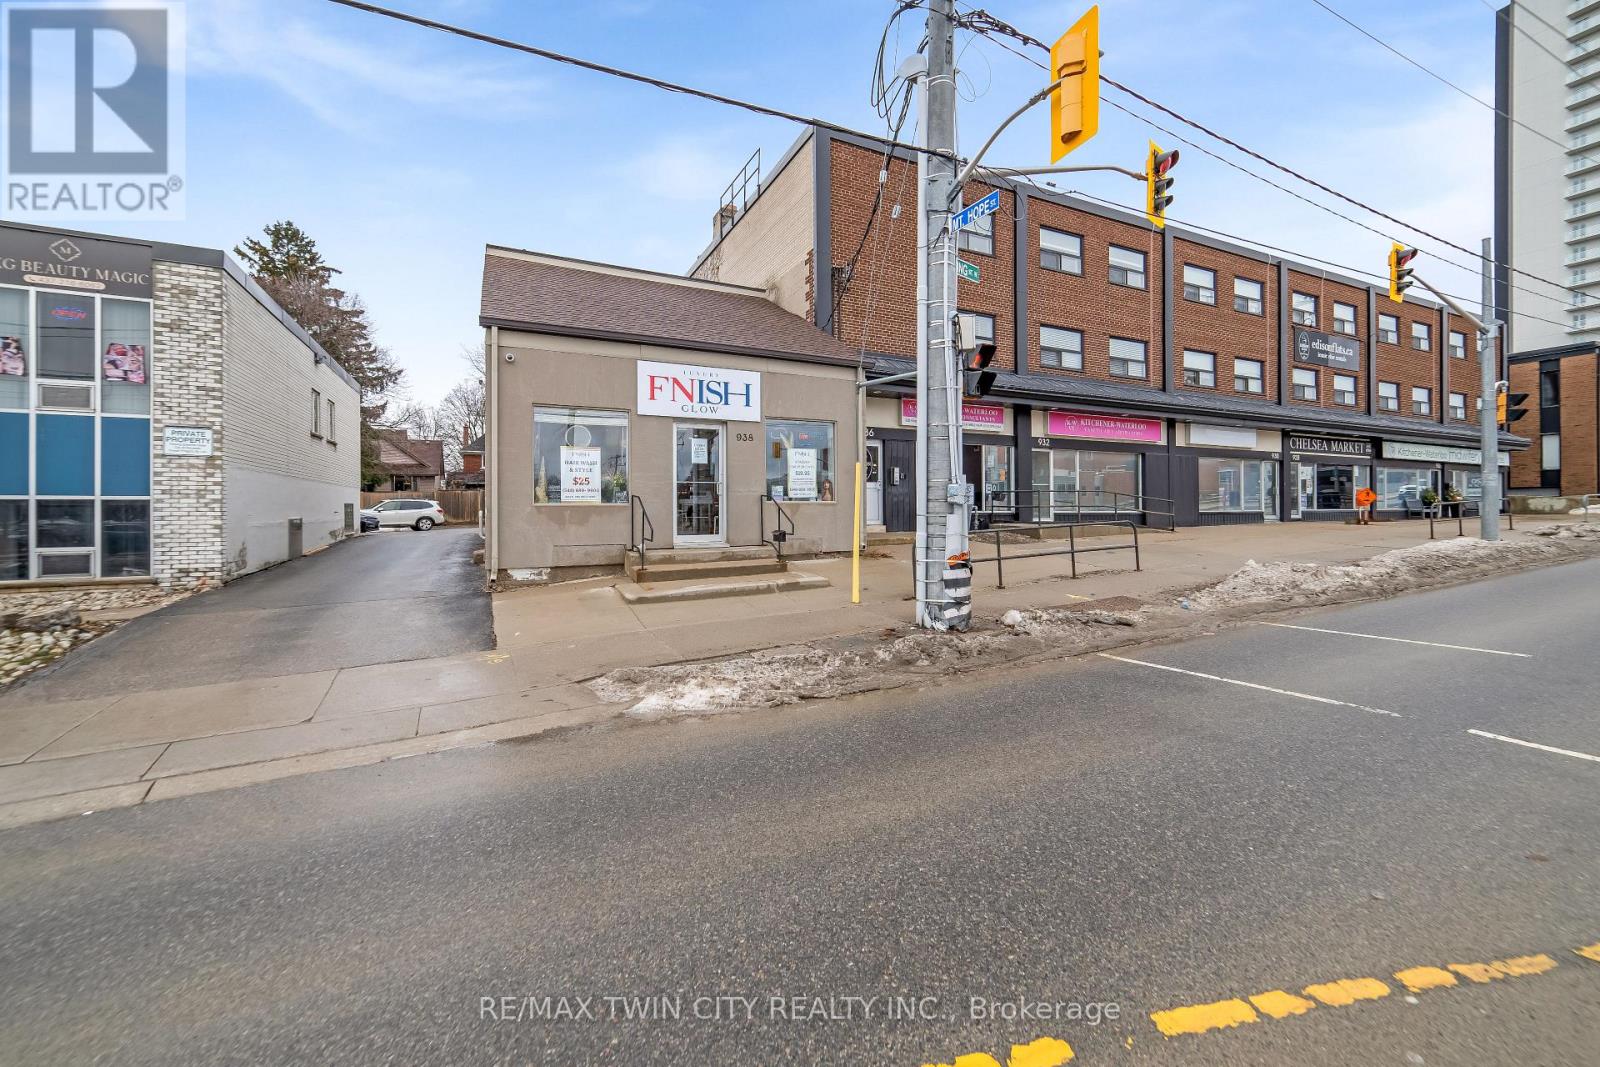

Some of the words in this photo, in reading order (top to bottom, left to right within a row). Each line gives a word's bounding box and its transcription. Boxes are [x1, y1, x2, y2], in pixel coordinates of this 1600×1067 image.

[953, 214, 965, 231] MT.
[967, 199, 990, 223] HOPE
[20, 259, 91, 279] BEAUTY
[95, 268, 149, 285] MAGIC
[959, 263, 968, 276] NG
[681, 404, 718, 414] GLOW
[961, 406, 998, 416] -WATERLOO
[1080, 418, 1147, 430] KITCHENER-WATERLOO
[171, 430, 206, 438] PRIVATE
[736, 433, 754, 442] 938
[166, 436, 210, 444] PROPERTY
[1037, 438, 1050, 446] 932
[1290, 437, 1328, 451] CHELSEA
[1330, 440, 1364, 454] MARKET
[572, 476, 590, 486] $25
